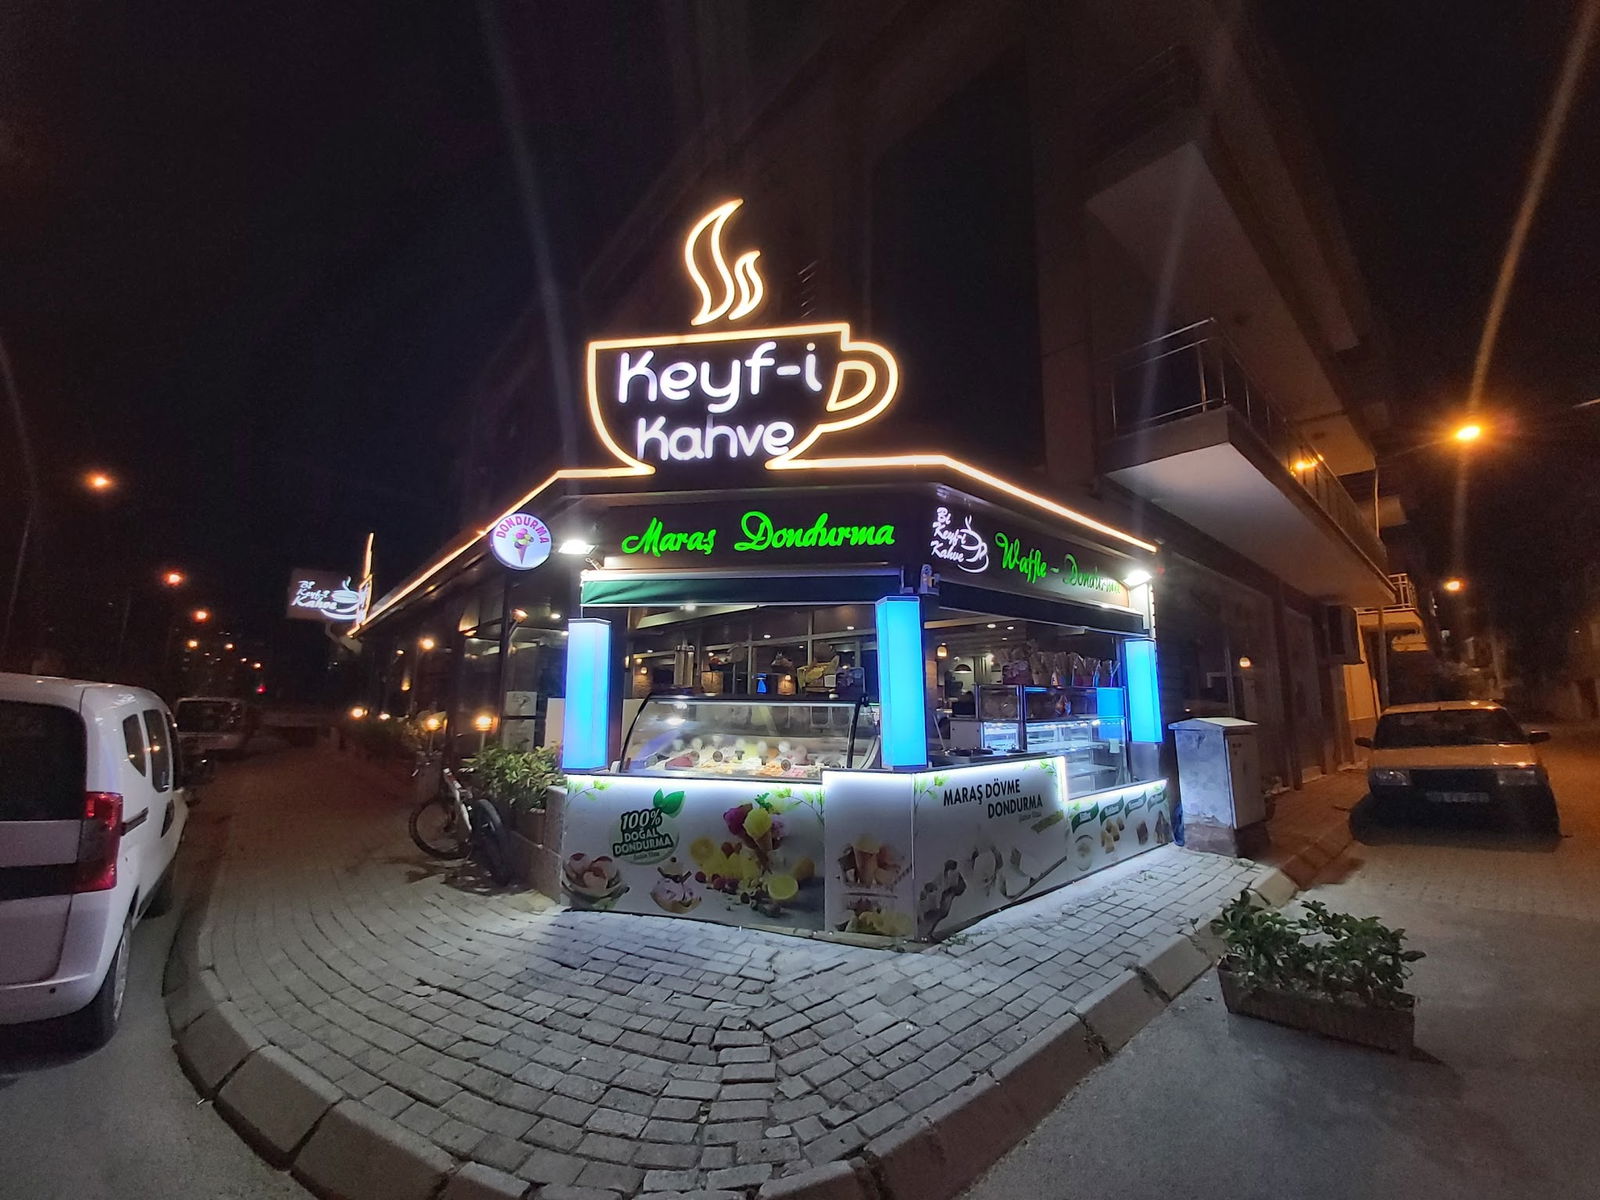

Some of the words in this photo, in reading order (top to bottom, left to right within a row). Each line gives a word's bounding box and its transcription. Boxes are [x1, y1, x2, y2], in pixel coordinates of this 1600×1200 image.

[618, 341, 822, 413] Keyf-i
[637, 415, 795, 461] Kahve
[495, 516, 550, 544] DONDURMA
[621, 517, 717, 557] Maraş
[734, 511, 895, 551] Dondurma
[995, 533, 1047, 584] Waffle
[943, 784, 984, 807] MARAŞ
[985, 778, 1020, 799] DÖVME
[987, 794, 1043, 819] DONDURMA
[621, 808, 662, 830] 100%
[613, 835, 672, 855] DONDURMA
[623, 828, 659, 843] DOĞAL
